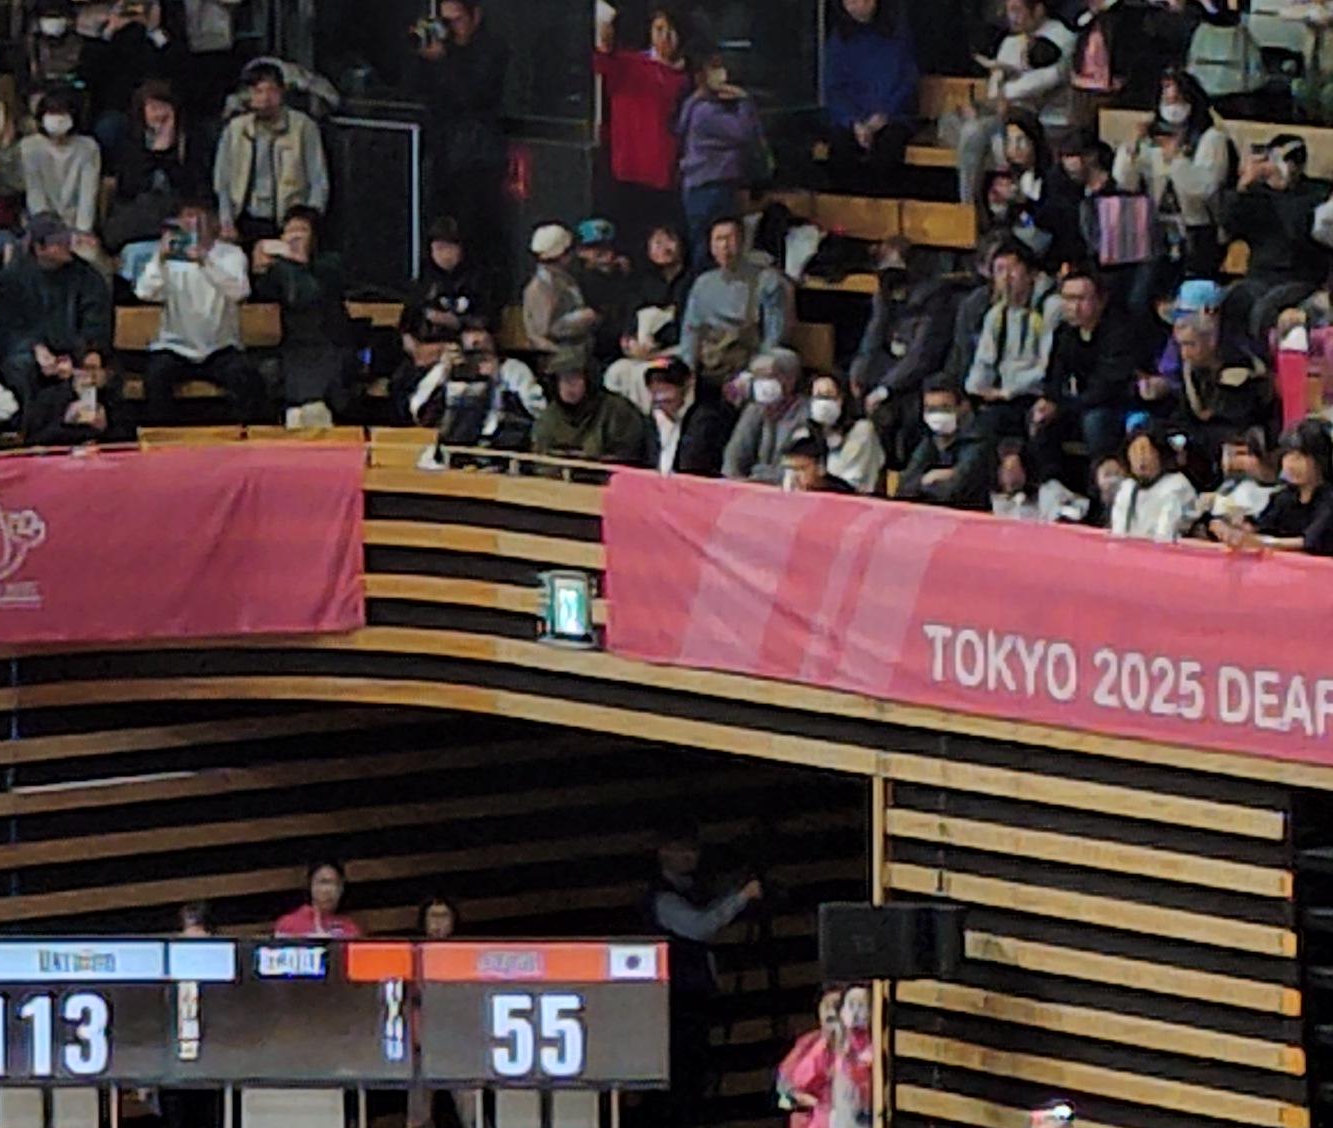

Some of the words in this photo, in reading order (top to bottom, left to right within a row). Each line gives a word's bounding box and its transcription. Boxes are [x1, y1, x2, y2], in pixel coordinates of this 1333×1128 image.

[922, 623, 1078, 701] TOKYO
[1092, 648, 1206, 720] 2025
[1217, 664, 1333, 736] DEAF
[490, 993, 584, 1077] 55
